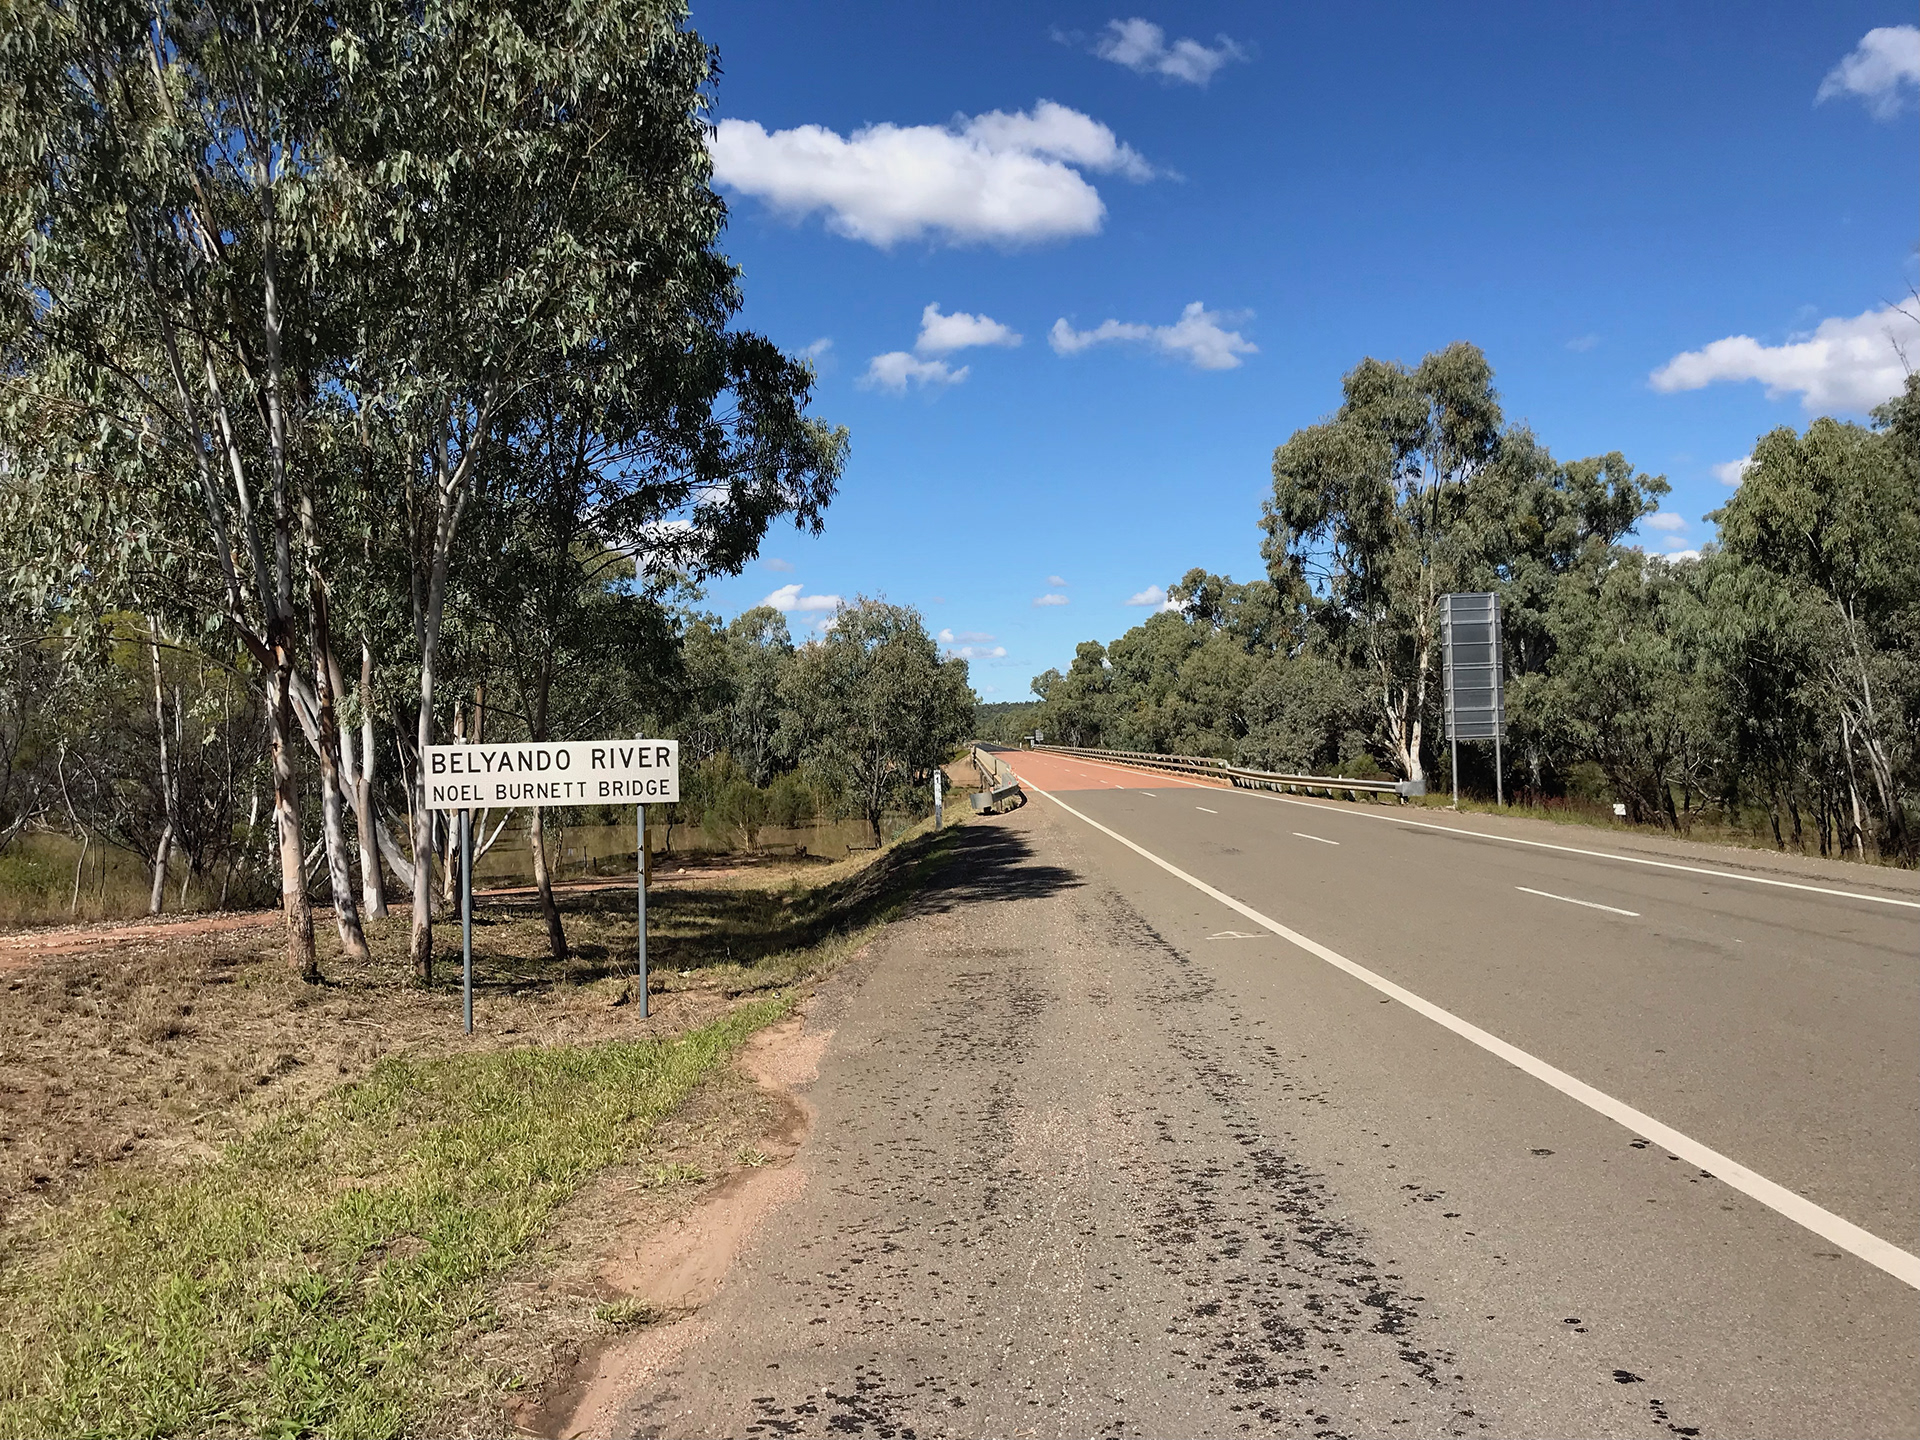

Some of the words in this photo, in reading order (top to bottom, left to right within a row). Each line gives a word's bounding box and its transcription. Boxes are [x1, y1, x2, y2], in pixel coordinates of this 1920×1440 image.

[431, 749, 571, 774] BELYANDO
[592, 746, 671, 769] RIVER
[433, 785, 484, 802] NOEL
[495, 781, 587, 800] BURNETT
[599, 779, 671, 797] BRIDGE
